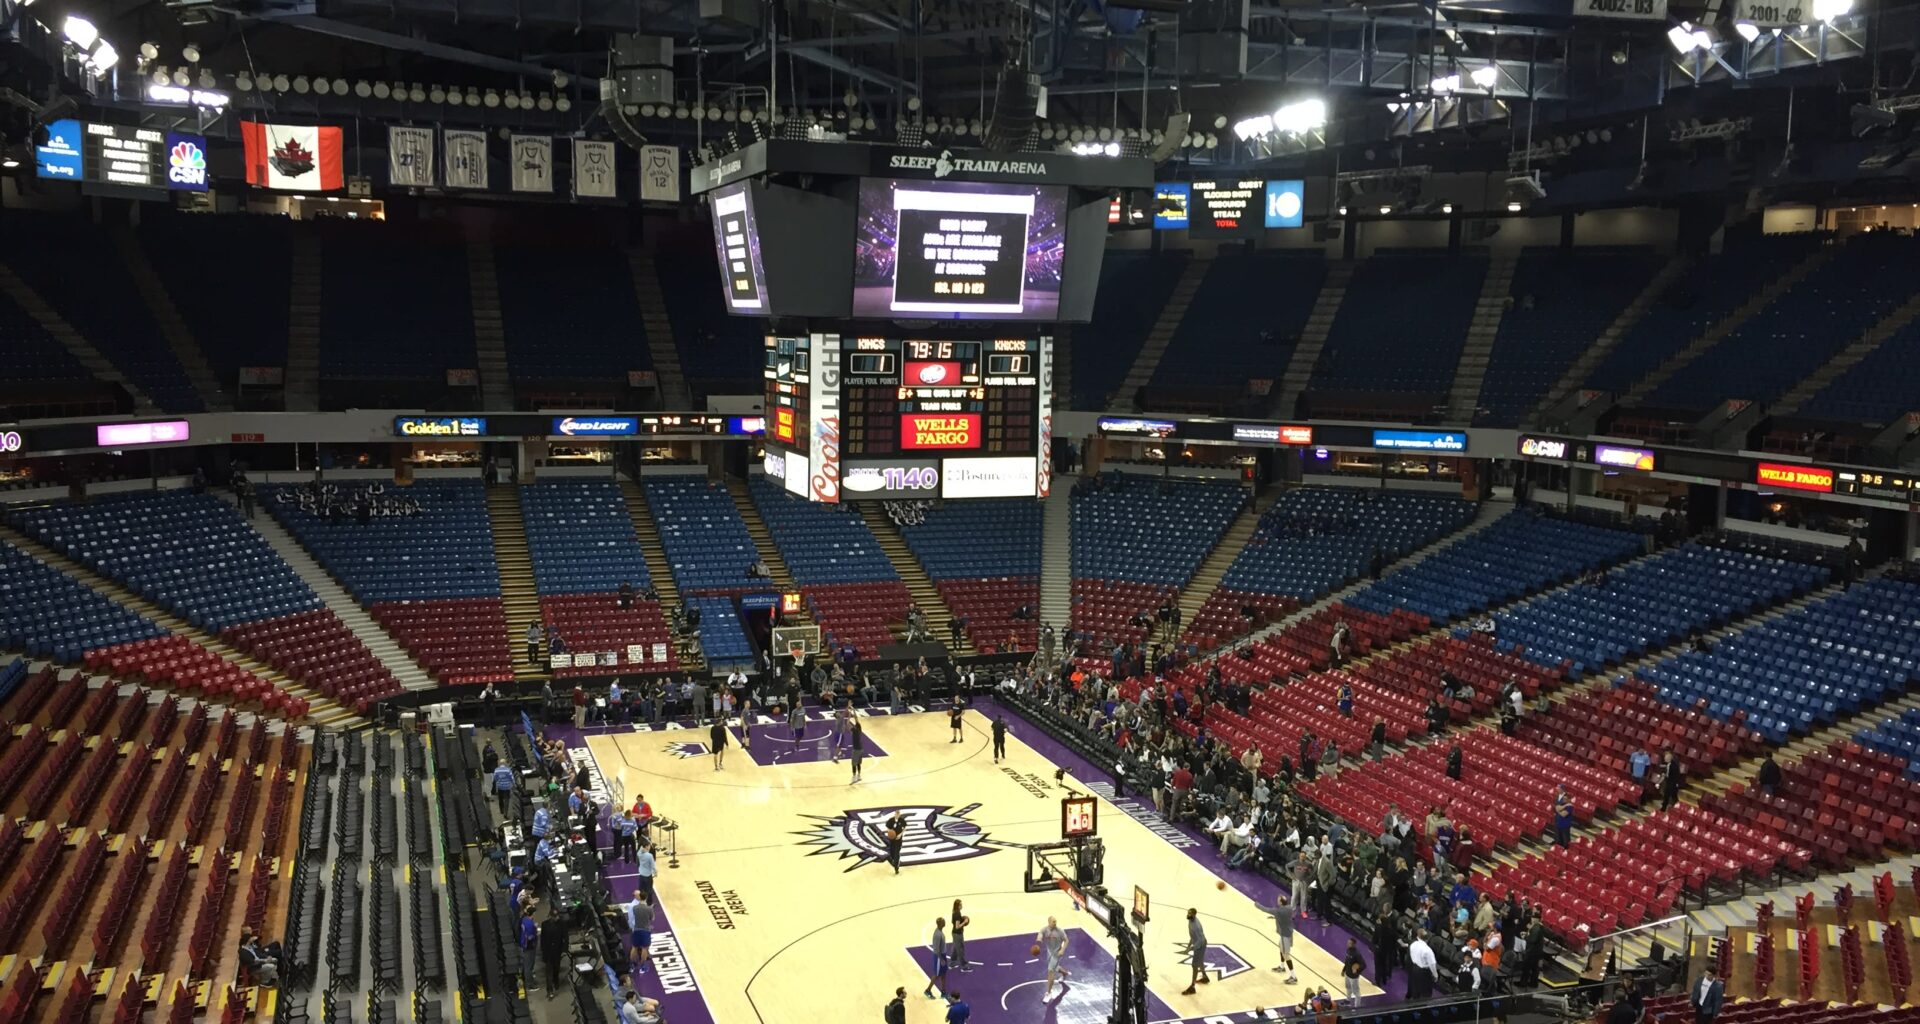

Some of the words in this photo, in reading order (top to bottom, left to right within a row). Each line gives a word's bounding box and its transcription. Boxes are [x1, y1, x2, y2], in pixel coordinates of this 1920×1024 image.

[1750, 5, 1802, 22] 2001-02
[400, 154, 414, 166] 27
[456, 156, 468, 169] 14
[889, 155, 936, 170] SLEEP
[954, 159, 1000, 172] TRAIN
[1000, 160, 1047, 174] ARENA
[169, 167, 206, 184] CSN
[591, 174, 603, 184] 11
[655, 177, 666, 188] 12
[1193, 182, 1215, 190] KINGS
[1238, 181, 1264, 189] GUEST
[1208, 200, 1246, 208] REBOUNDS
[858, 339, 885, 350] KINGS
[910, 342, 952, 358] 79:15
[994, 340, 1026, 351] KNICKS
[822, 334, 840, 409] LIGHT
[879, 355, 885, 372] 1
[971, 363, 977, 375] 1
[1010, 356, 1021, 372] 0
[1043, 336, 1053, 409] LIGHT
[566, 421, 593, 430] BUD
[593, 422, 630, 430] LIGHT
[914, 419, 969, 430] WELLS
[916, 433, 969, 444] FARGO
[1538, 441, 1565, 458] CSN
[812, 414, 840, 502] Coors
[883, 467, 938, 489] 1140
[1760, 469, 1794, 482] WELLS
[1797, 472, 1832, 486] FARGO
[999, 767, 1026, 783] TRAIN
[1025, 773, 1054, 790] ARENA
[1020, 783, 1050, 799] SLEEP
[694, 880, 721, 903] TRAIN
[721, 889, 749, 915] ARENA
[708, 904, 736, 930] SLEEP
[649, 931, 697, 994] KINGS.COM
